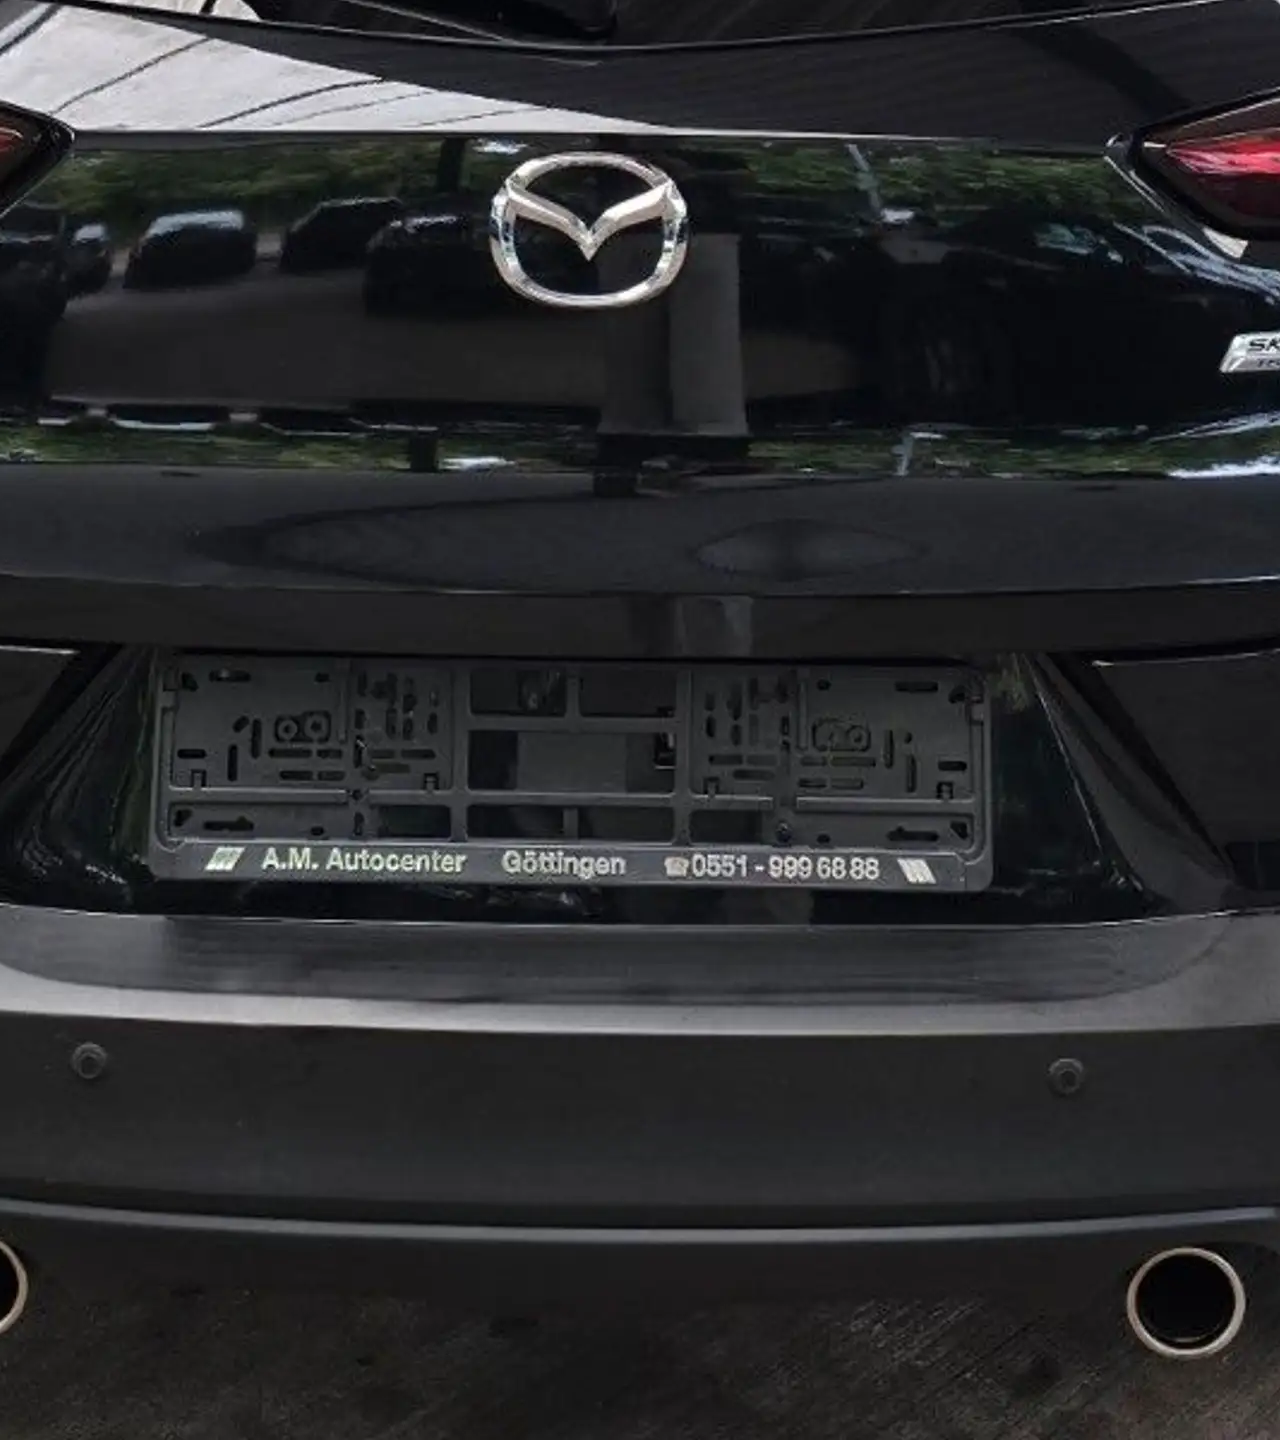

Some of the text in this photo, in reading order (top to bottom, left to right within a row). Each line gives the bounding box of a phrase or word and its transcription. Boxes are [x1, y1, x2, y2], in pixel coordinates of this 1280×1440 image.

[260, 847, 319, 870] A.M.
[325, 847, 469, 874] Autocenter
[501, 849, 627, 880] Göttingen
